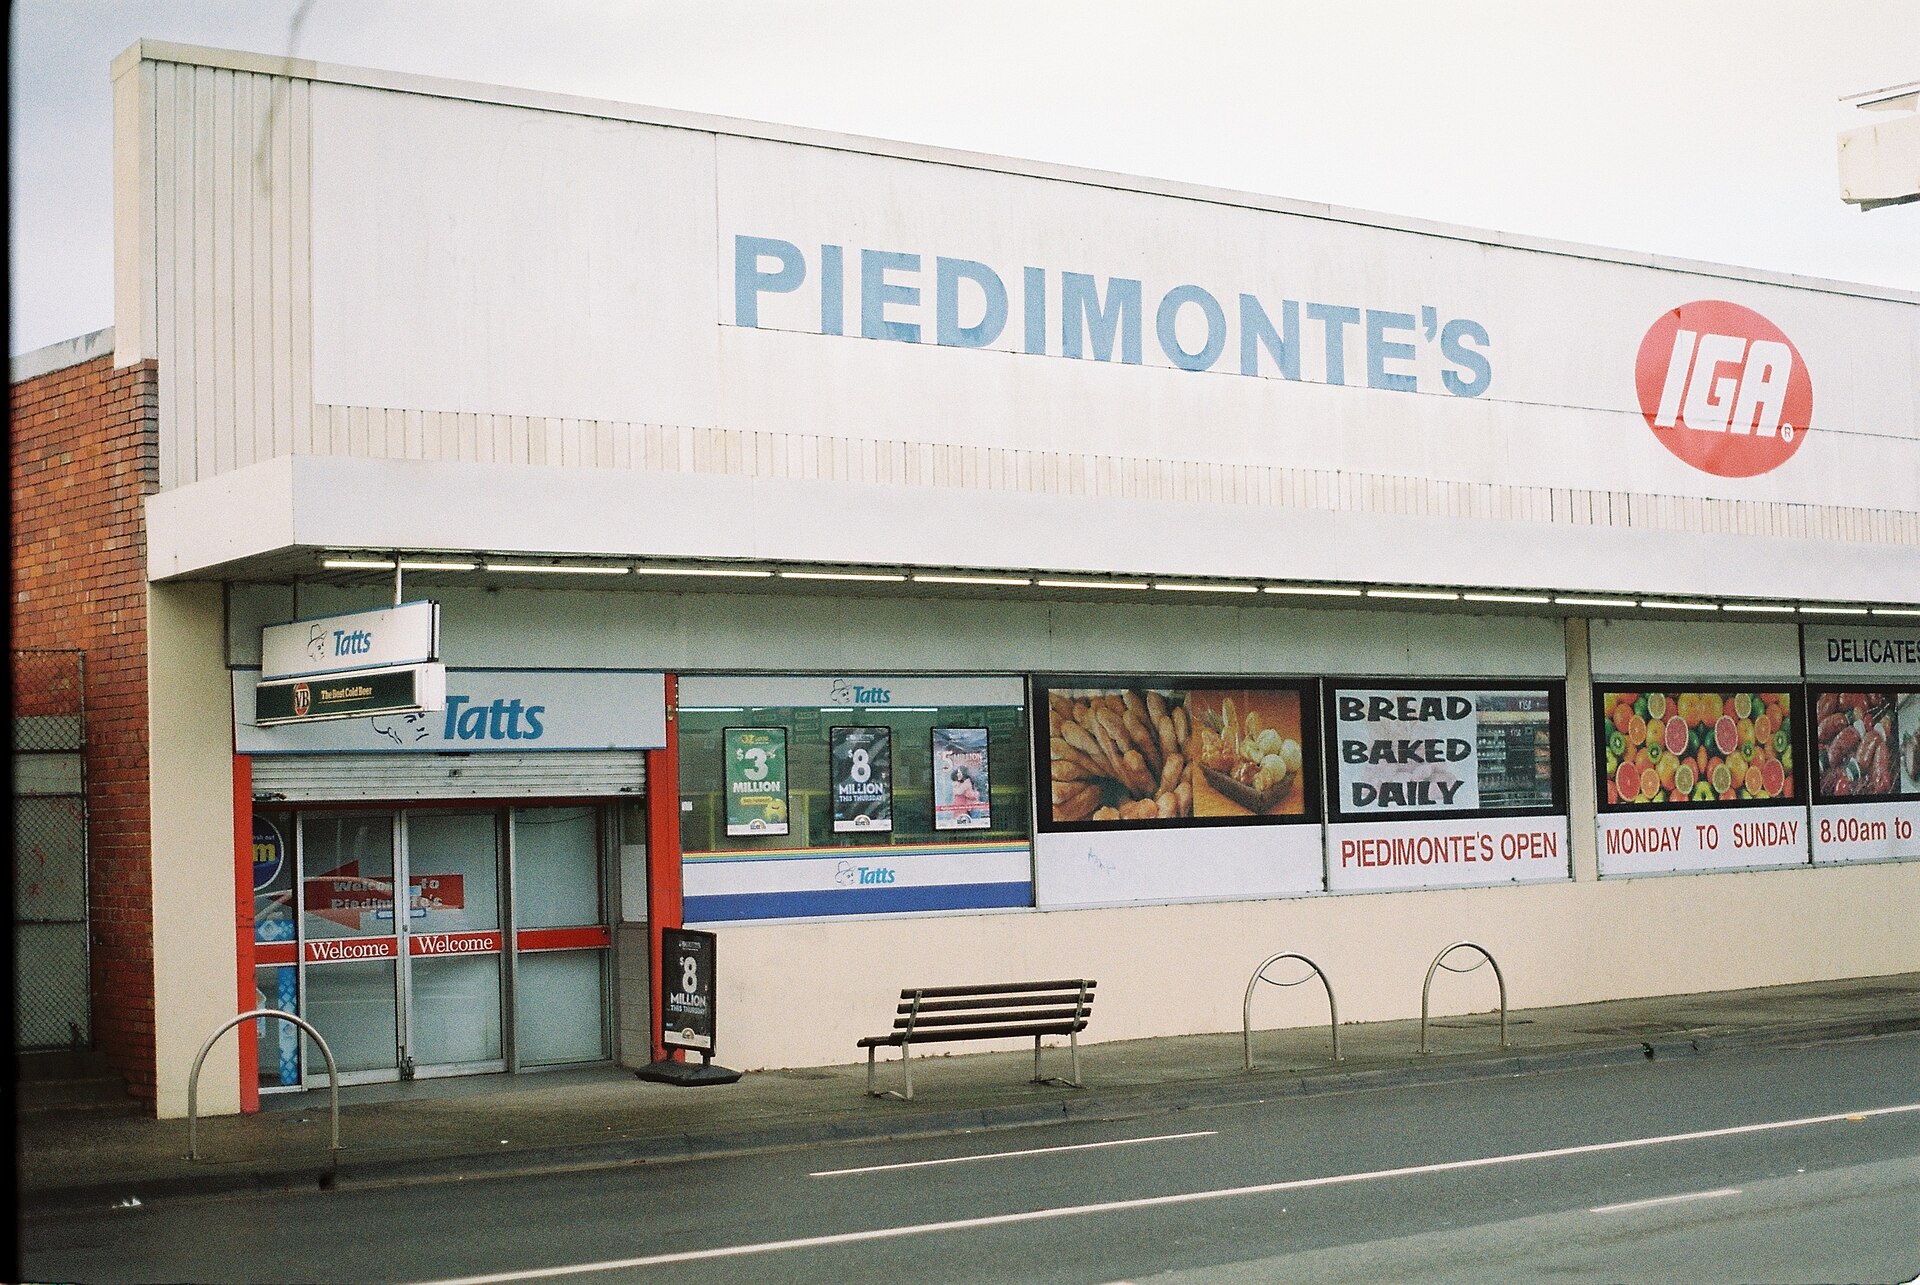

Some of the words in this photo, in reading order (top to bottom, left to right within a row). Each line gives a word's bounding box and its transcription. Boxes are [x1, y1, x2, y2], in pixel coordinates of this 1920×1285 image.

[734, 234, 1492, 398] PIEDIMONTE'S
[333, 630, 371, 656] Tatts
[296, 690, 309, 707] VB
[853, 686, 890, 703] Tatts
[443, 695, 545, 741] Tatts
[1339, 696, 1472, 722] BREAD
[1342, 738, 1472, 764] BAKED
[733, 781, 780, 794] MILLION
[839, 783, 883, 796] MILLION
[1352, 780, 1465, 807] DAILY
[1606, 826, 1681, 855] MONDAY
[1696, 824, 1719, 850] TO
[1733, 820, 1798, 848] SUNDAY
[1820, 816, 1887, 843] 8.00am
[1895, 816, 1912, 840] to
[1341, 831, 1494, 868] PIEDIMONTE'S
[1500, 832, 1557, 861] OPEN
[858, 867, 895, 884] Tatts
[310, 942, 389, 960] Welcome
[417, 936, 493, 954] Welcome
[670, 992, 706, 1007] MILLION
